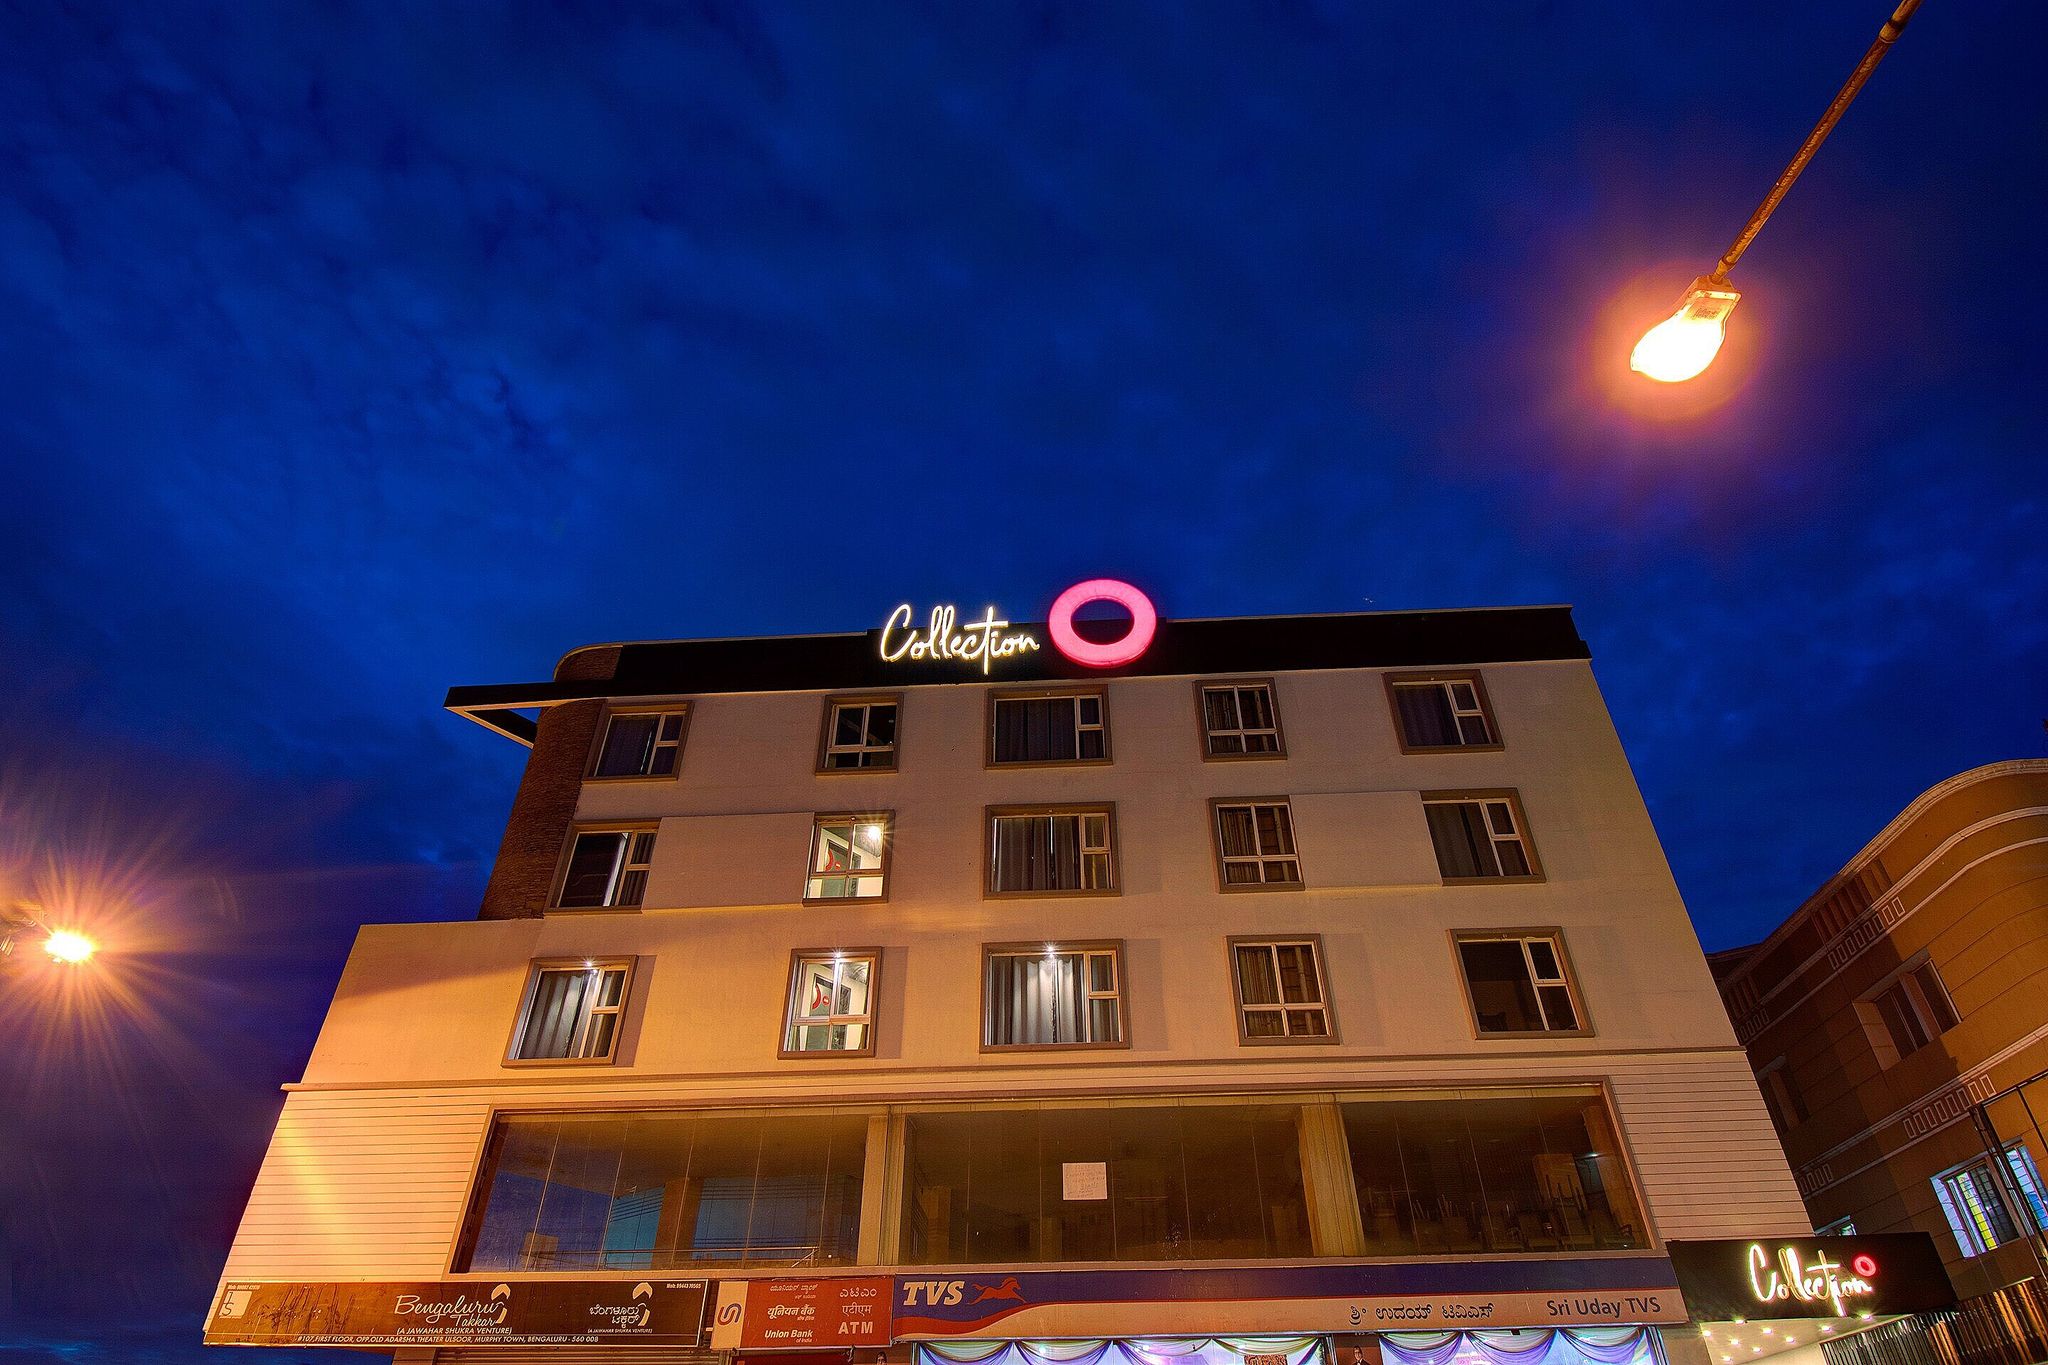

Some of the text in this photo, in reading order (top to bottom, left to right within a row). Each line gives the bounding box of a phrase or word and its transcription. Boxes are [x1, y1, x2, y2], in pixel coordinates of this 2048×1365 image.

[879, 603, 1040, 676] Collection
[1748, 1242, 1874, 1318] Collection
[839, 1286, 878, 1298] ಎಟಿಎಂ
[902, 1280, 966, 1307] TVS
[394, 1294, 501, 1324] Bengaluru
[767, 1304, 800, 1320] यूनियन
[841, 1301, 873, 1317] एटीएम
[1546, 1296, 1661, 1319] Sri Uday TVS
[449, 1313, 497, 1327] Takkar
[838, 1321, 874, 1335] ATM
[406, 1327, 443, 1335] JAWAHAR
[445, 1327, 475, 1335] SHUKRA
[477, 1327, 513, 1335] VENTURE)
[764, 1329, 813, 1338] Union Bank
[384, 1336, 416, 1344] ADARSHA
[417, 1336, 444, 1344] THEATER
[445, 1336, 473, 1344] ULSOOR,
